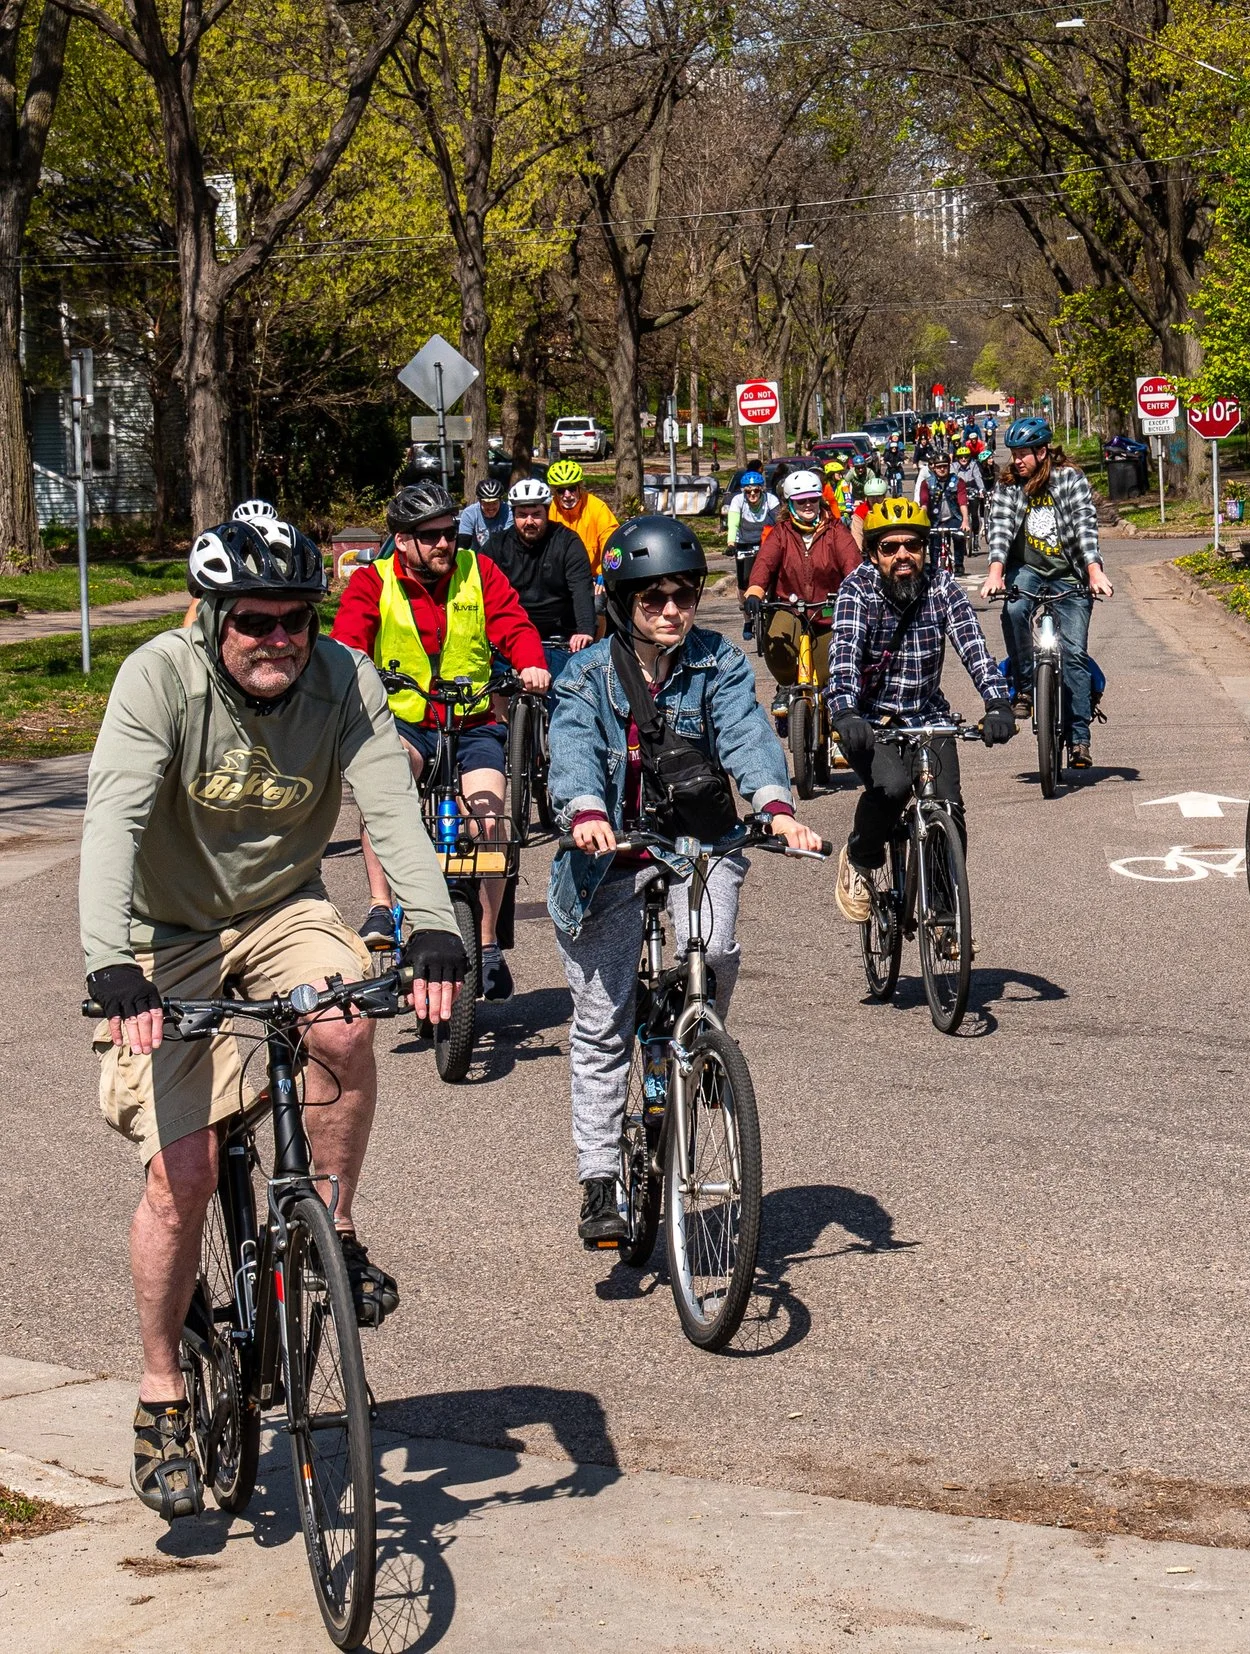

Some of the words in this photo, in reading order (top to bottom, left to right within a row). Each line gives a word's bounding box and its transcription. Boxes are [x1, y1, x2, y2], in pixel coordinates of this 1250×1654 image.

[1143, 385, 1154, 393] DO
[743, 392, 754, 400] DO
[757, 390, 772, 399] NOT
[1146, 402, 1170, 410] ENTER
[747, 409, 770, 417] ENTER
[1190, 401, 1237, 423] STOP
[1026, 532, 1061, 556] OFFEE
[196, 773, 300, 810] Bekley
